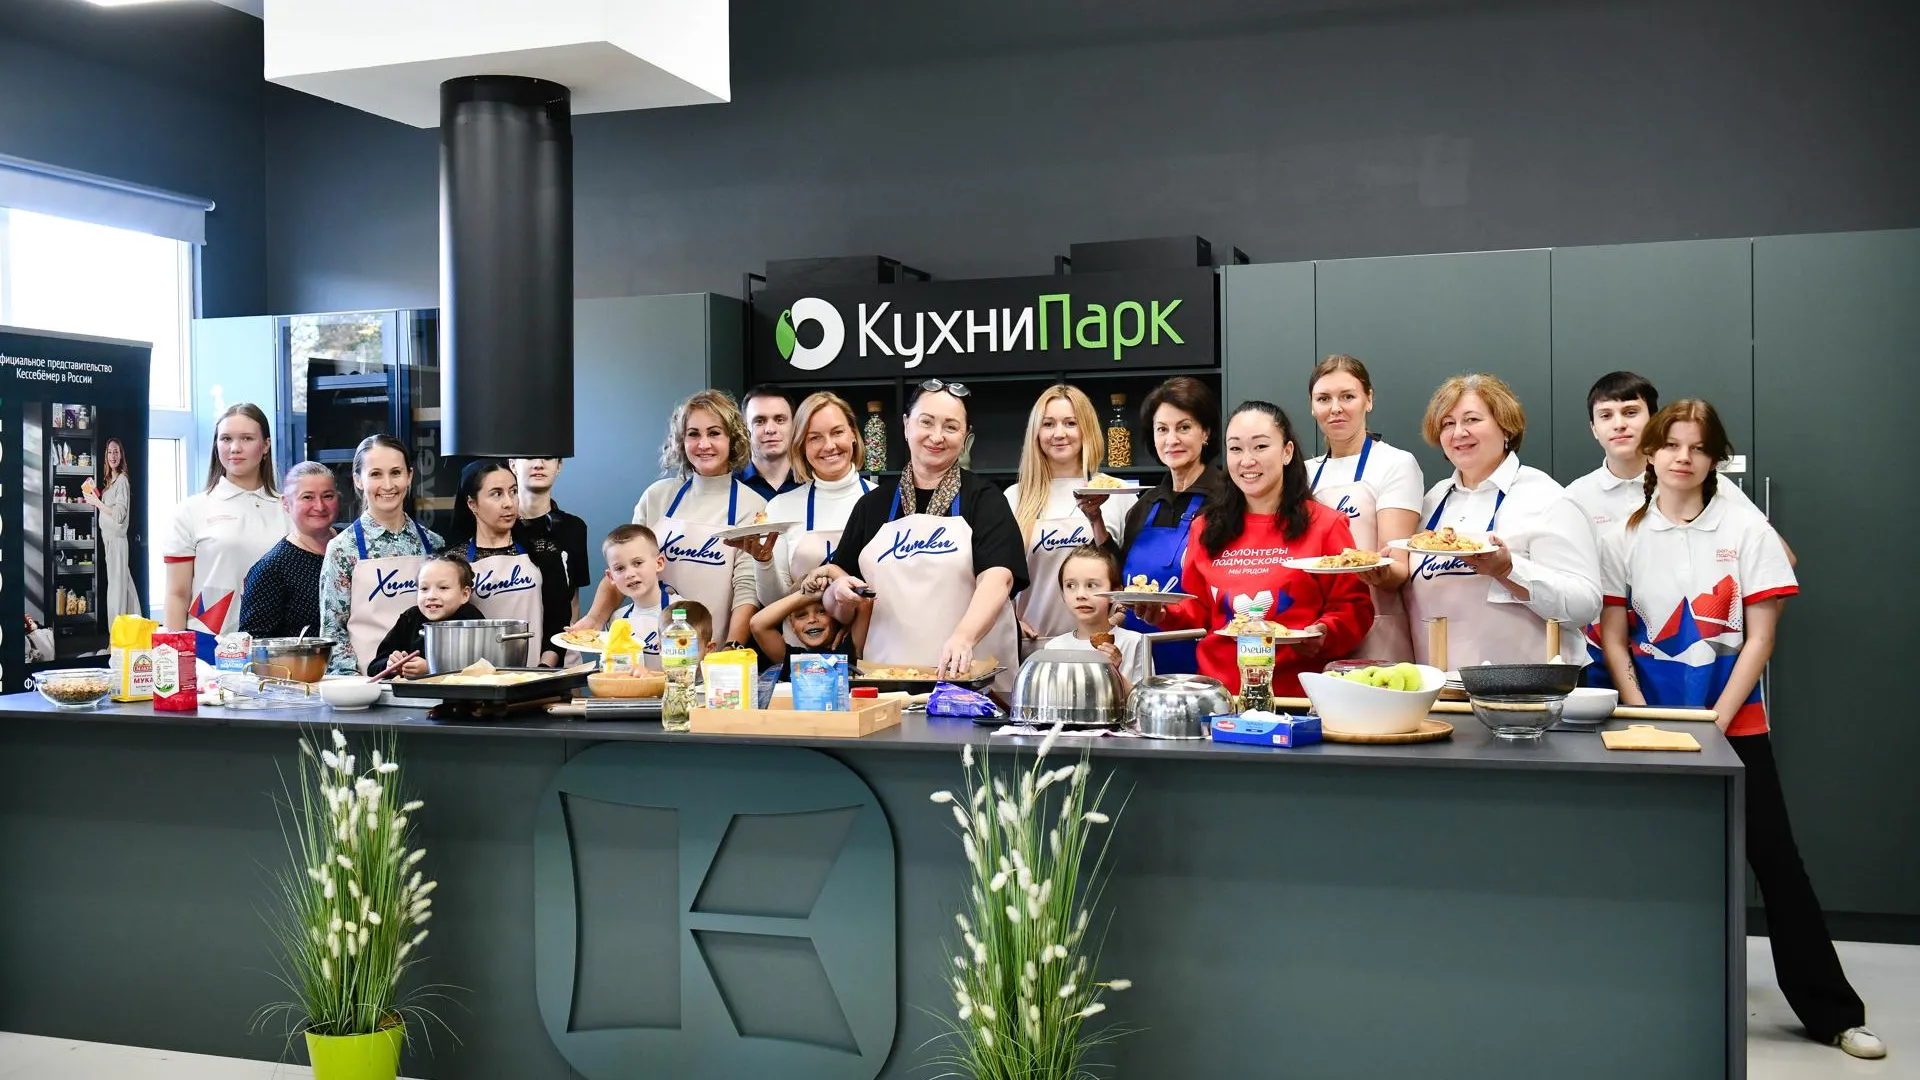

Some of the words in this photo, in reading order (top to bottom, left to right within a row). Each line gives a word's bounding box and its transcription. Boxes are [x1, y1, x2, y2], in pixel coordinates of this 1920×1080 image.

[858, 293, 1185, 369] КухниПарк
[0, 353, 45, 367] фициальное
[47, 359, 112, 373] представительство
[16, 368, 60, 383] Кессебёмер
[67, 372, 92, 383] России
[659, 530, 726, 565] Химки
[878, 527, 958, 563] Химки
[1032, 526, 1090, 554] Химки
[1222, 547, 1289, 558] ВОЛОНТЕРЫ
[369, 568, 417, 602] Хим
[472, 565, 536, 599] Химки
[1242, 567, 1270, 575] РЯДОМ
